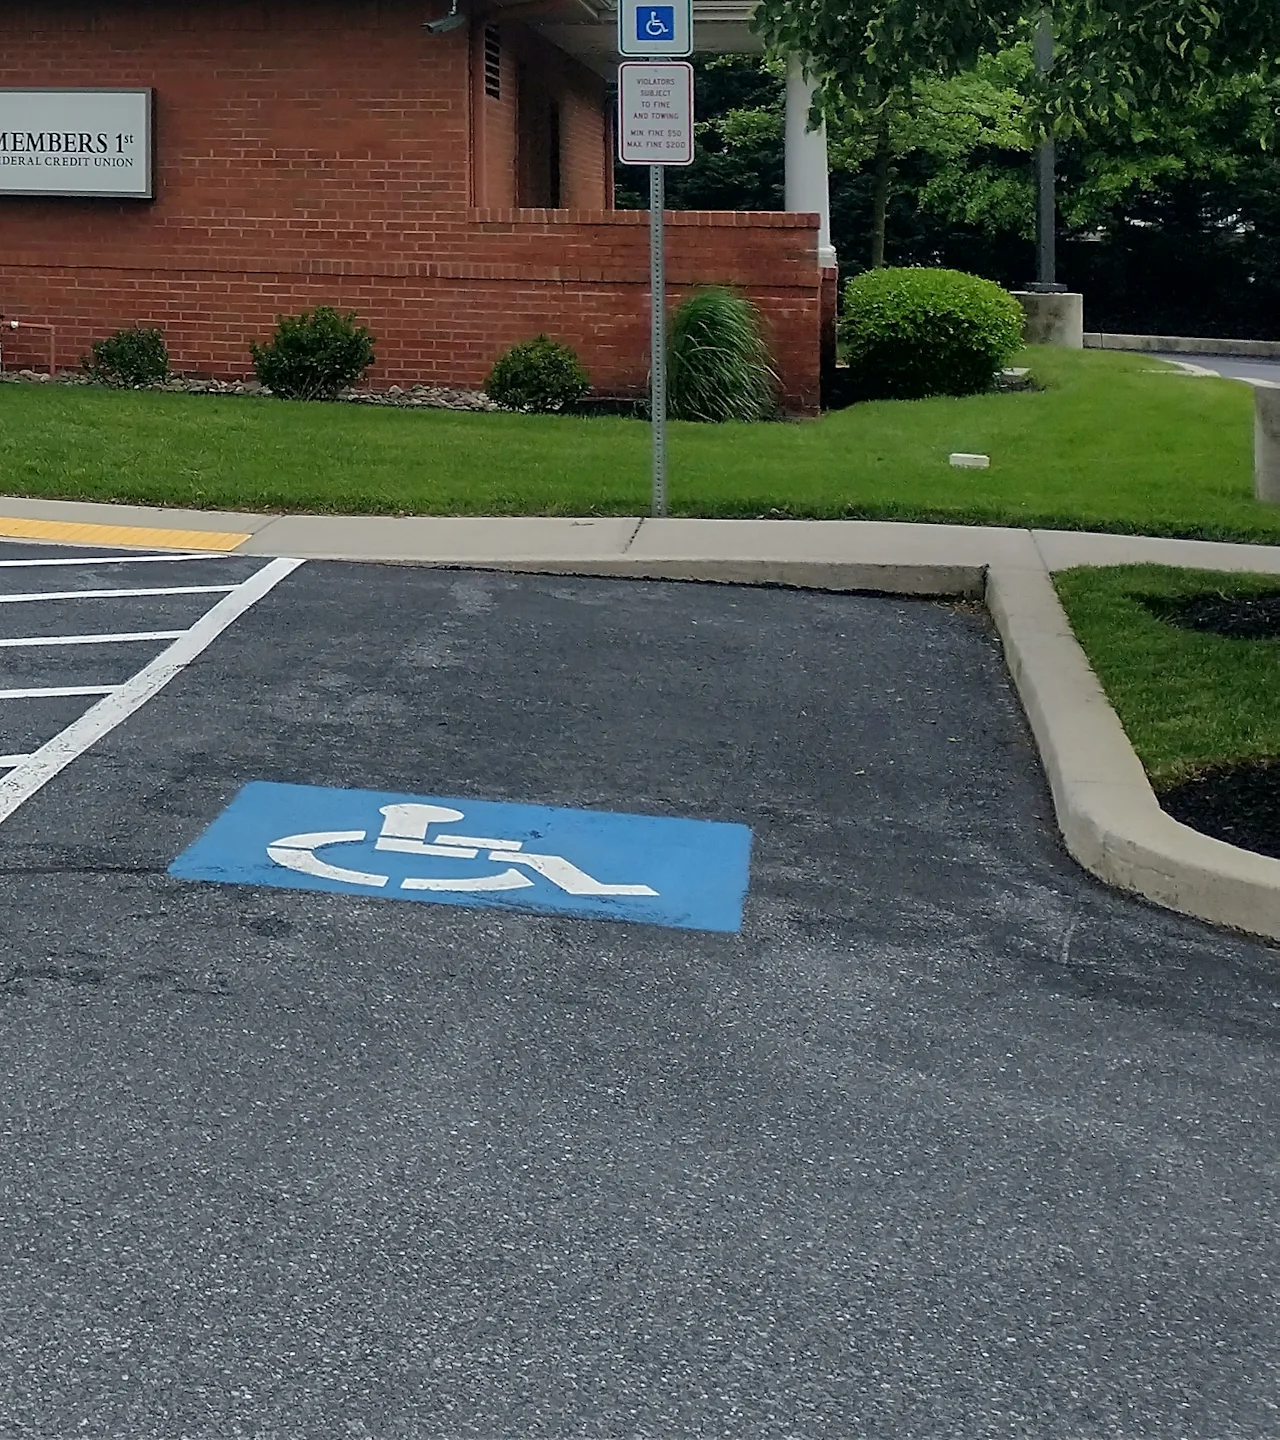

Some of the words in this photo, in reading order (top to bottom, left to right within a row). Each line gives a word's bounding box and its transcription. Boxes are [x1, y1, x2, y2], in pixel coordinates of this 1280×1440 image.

[667, 129, 682, 137] $50
[116, 133, 134, 153] 1st
[44, 157, 90, 166] CREDIT
[94, 158, 133, 167] UNION
